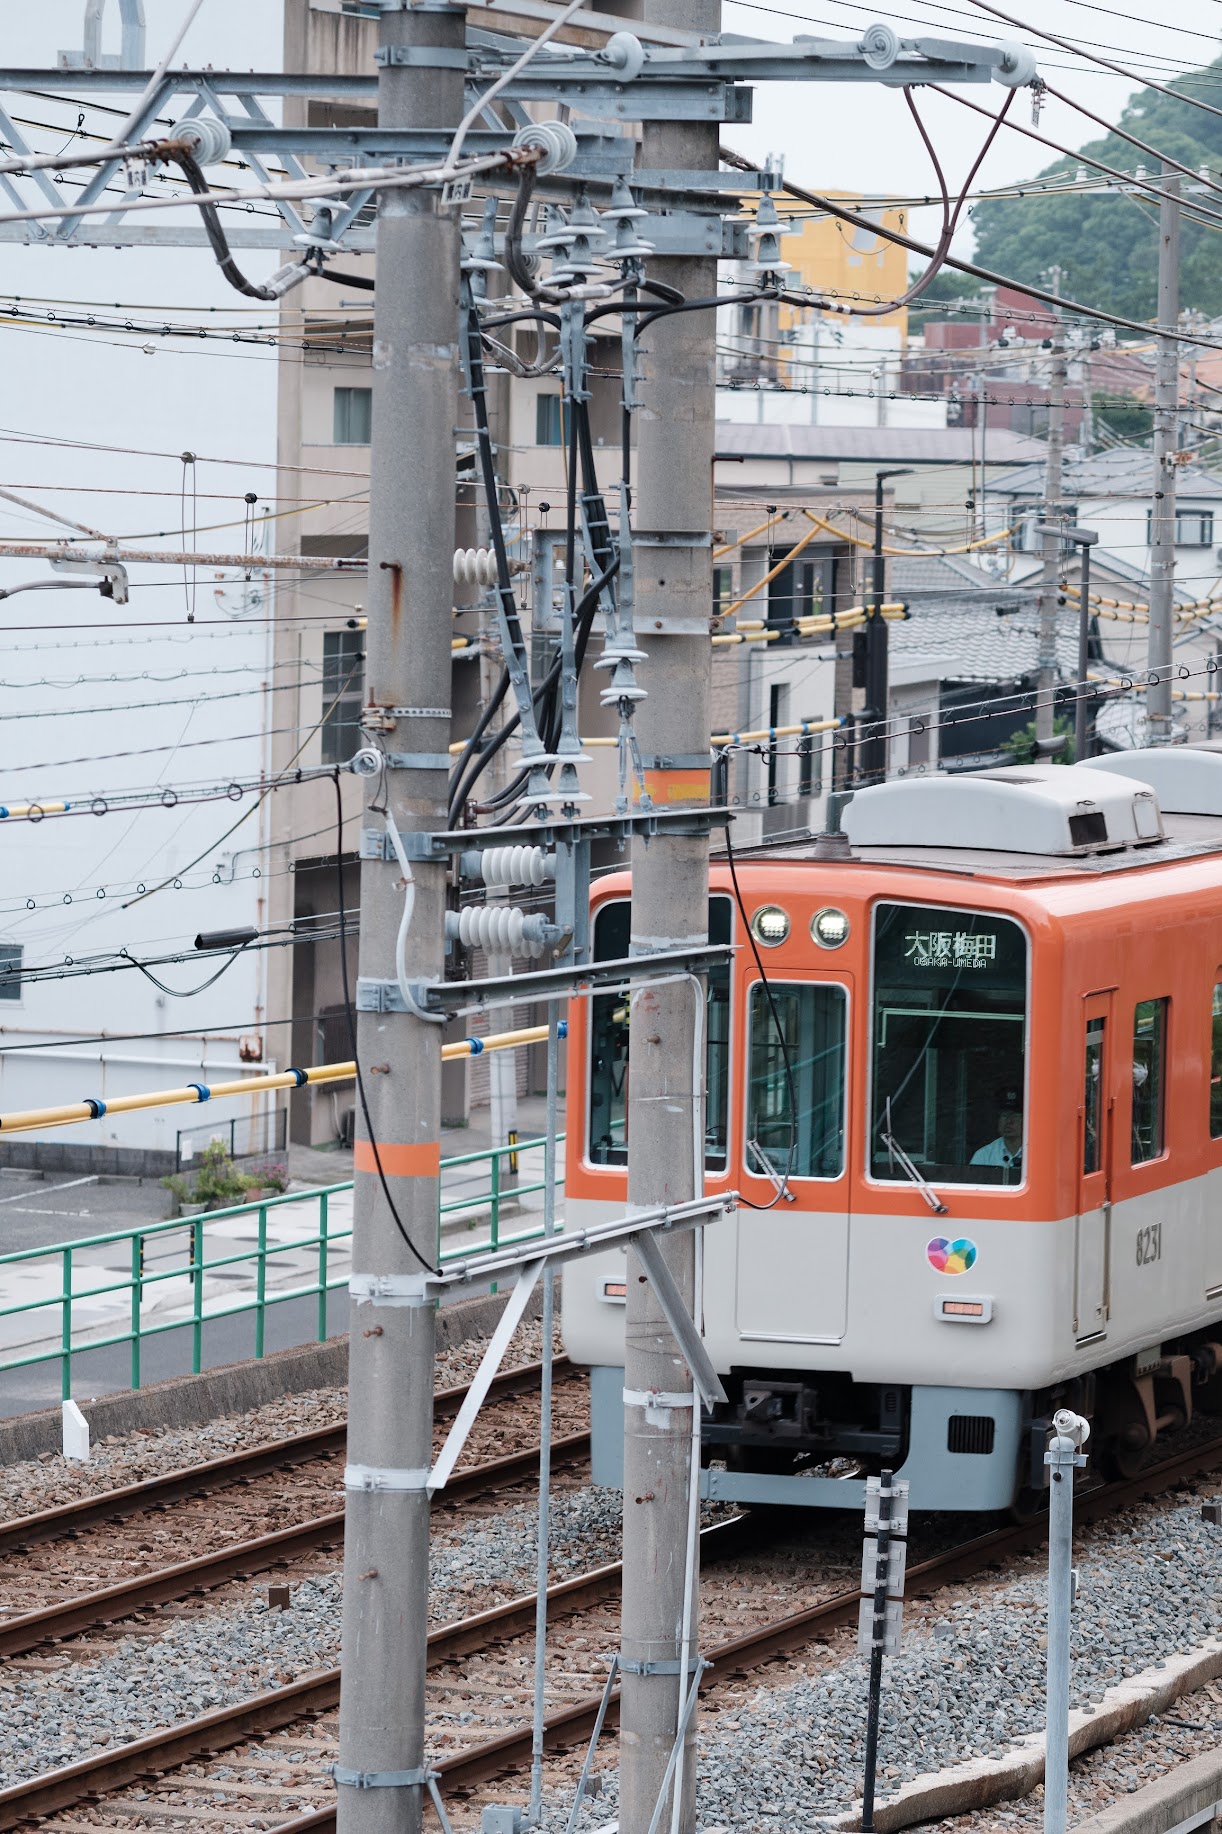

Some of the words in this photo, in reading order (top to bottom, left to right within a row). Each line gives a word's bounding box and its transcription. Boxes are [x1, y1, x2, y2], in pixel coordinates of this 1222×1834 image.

[904, 931, 997, 960] 大阪梅田
[913, 956, 987, 968] OSAKA-UMEDA
[1136, 1222, 1162, 1266] 8231
